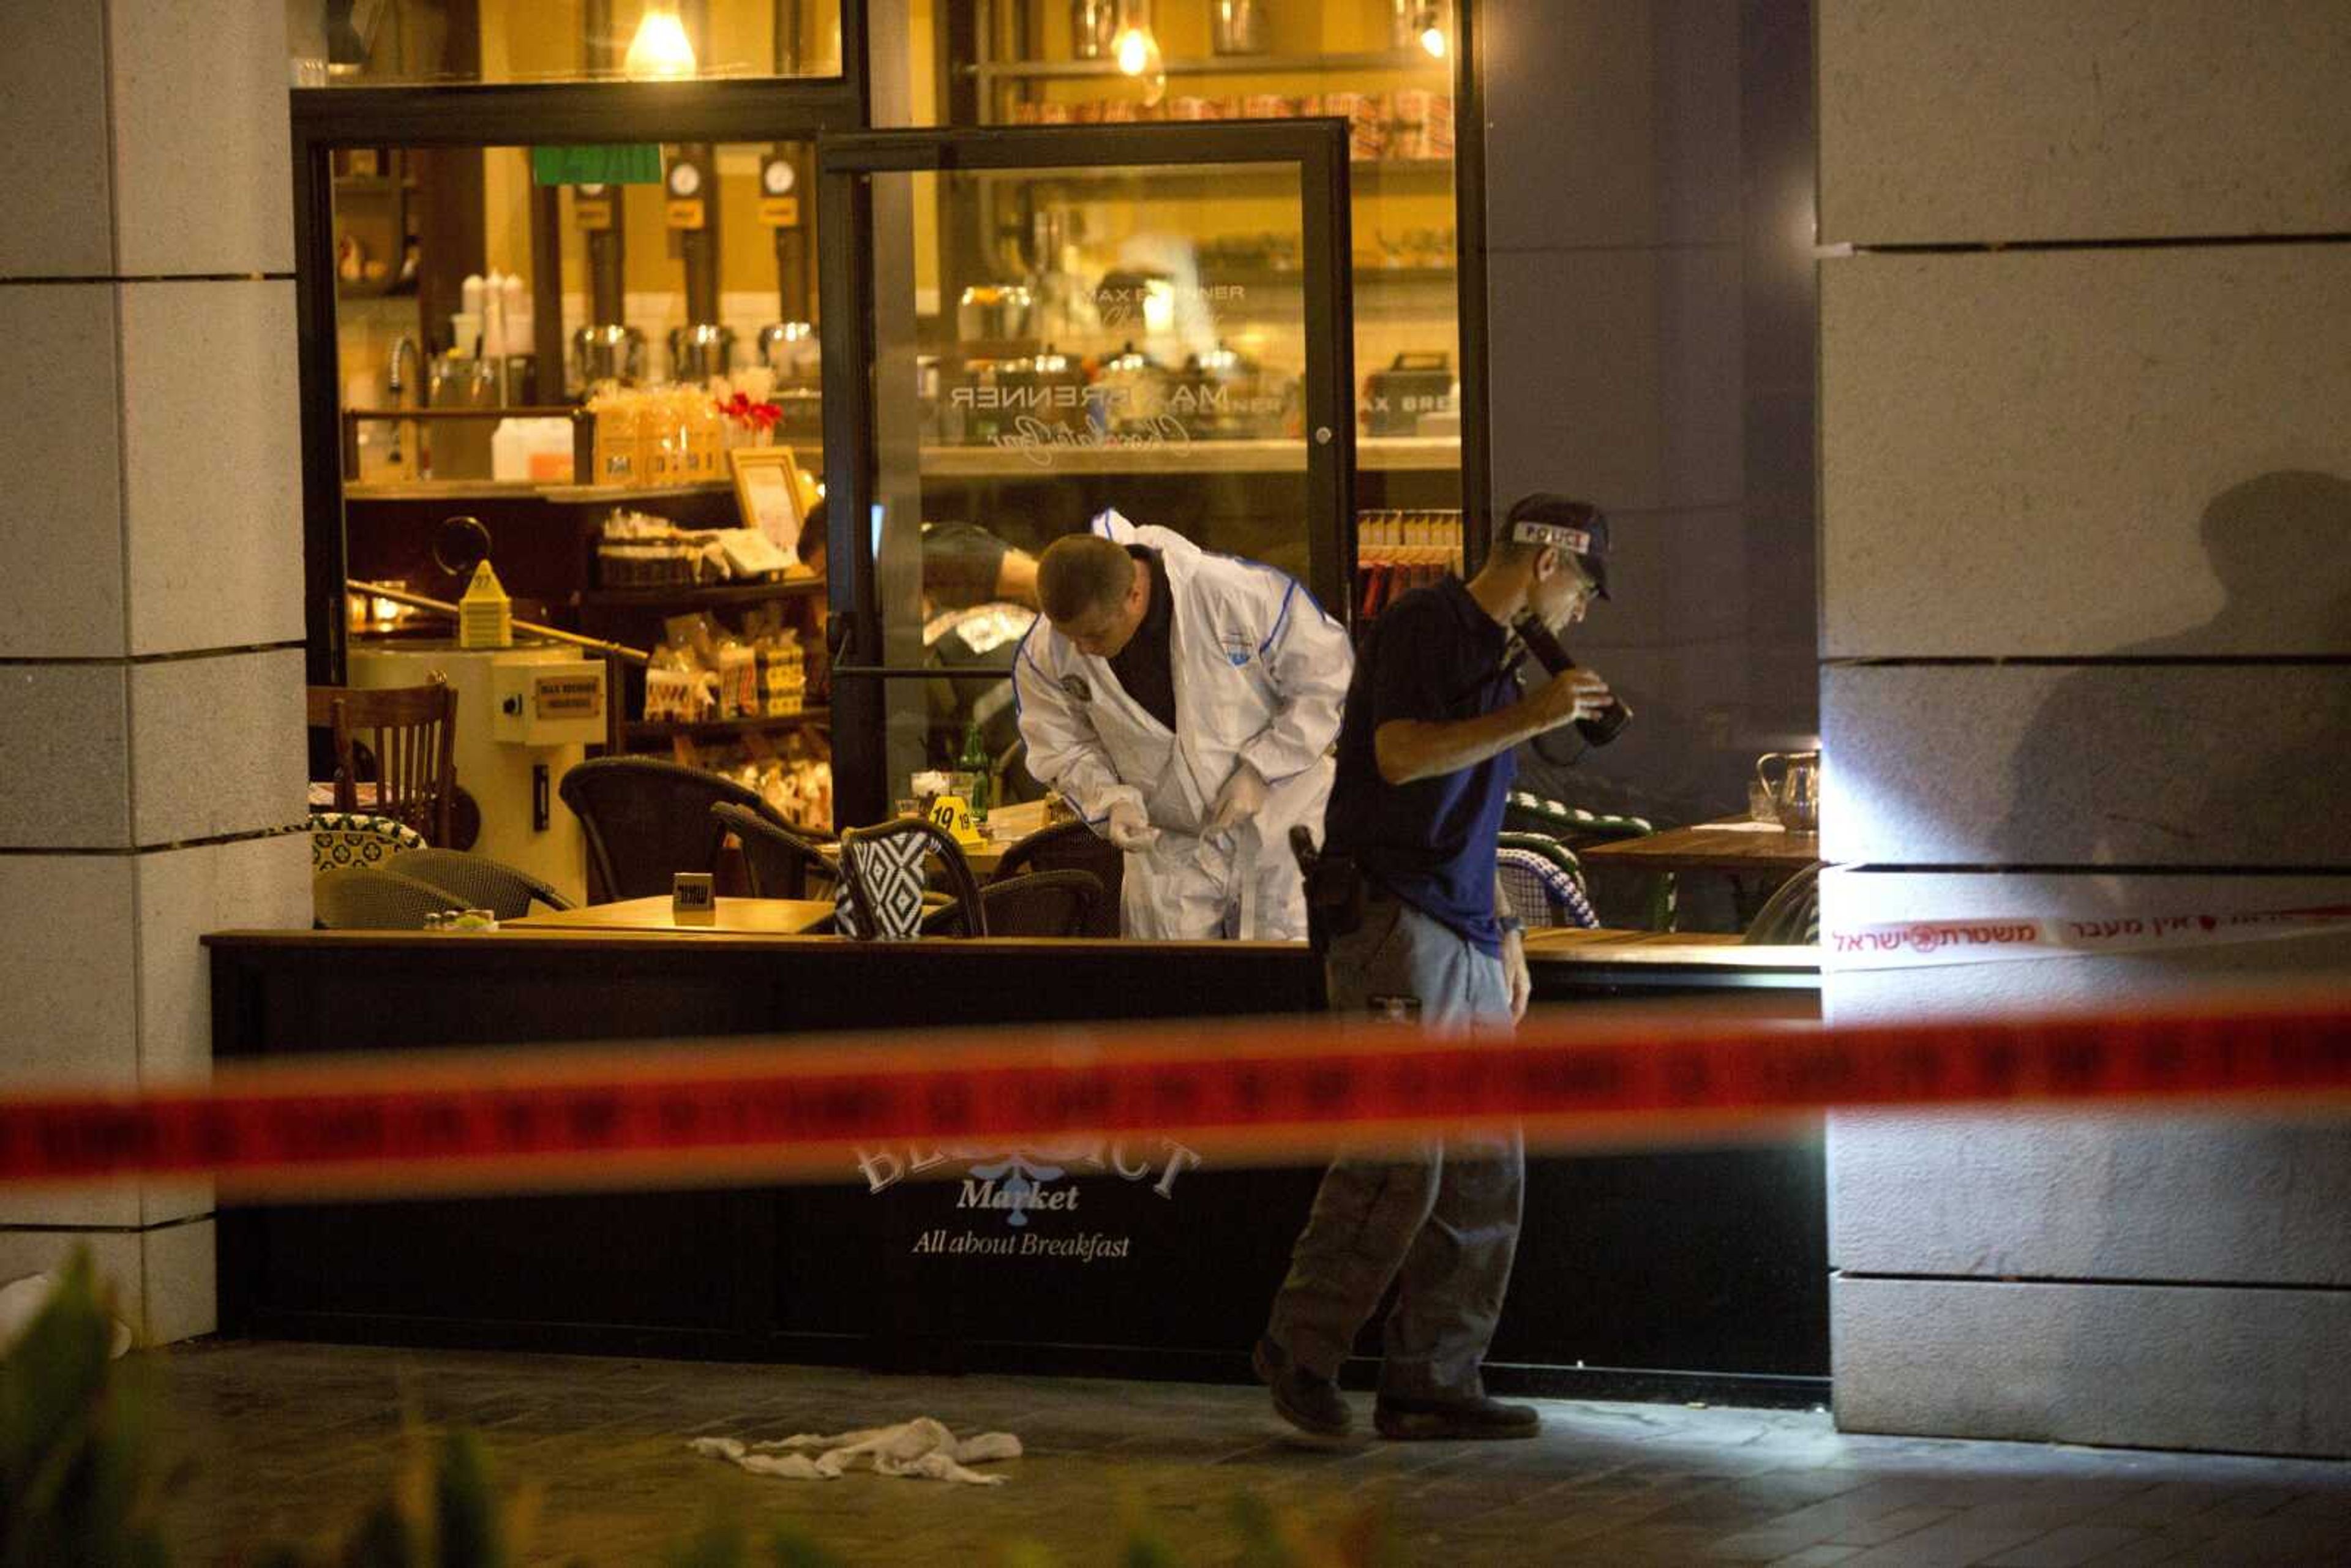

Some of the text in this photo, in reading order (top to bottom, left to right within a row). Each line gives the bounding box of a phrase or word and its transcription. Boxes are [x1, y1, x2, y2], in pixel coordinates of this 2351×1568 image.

[932, 805, 954, 831] 19
[1832, 928, 1909, 953] ישראל
[1940, 923, 2036, 946] משטרת
[957, 1179, 1081, 1210] Market
[912, 1230, 1130, 1263] All about Breakfast
